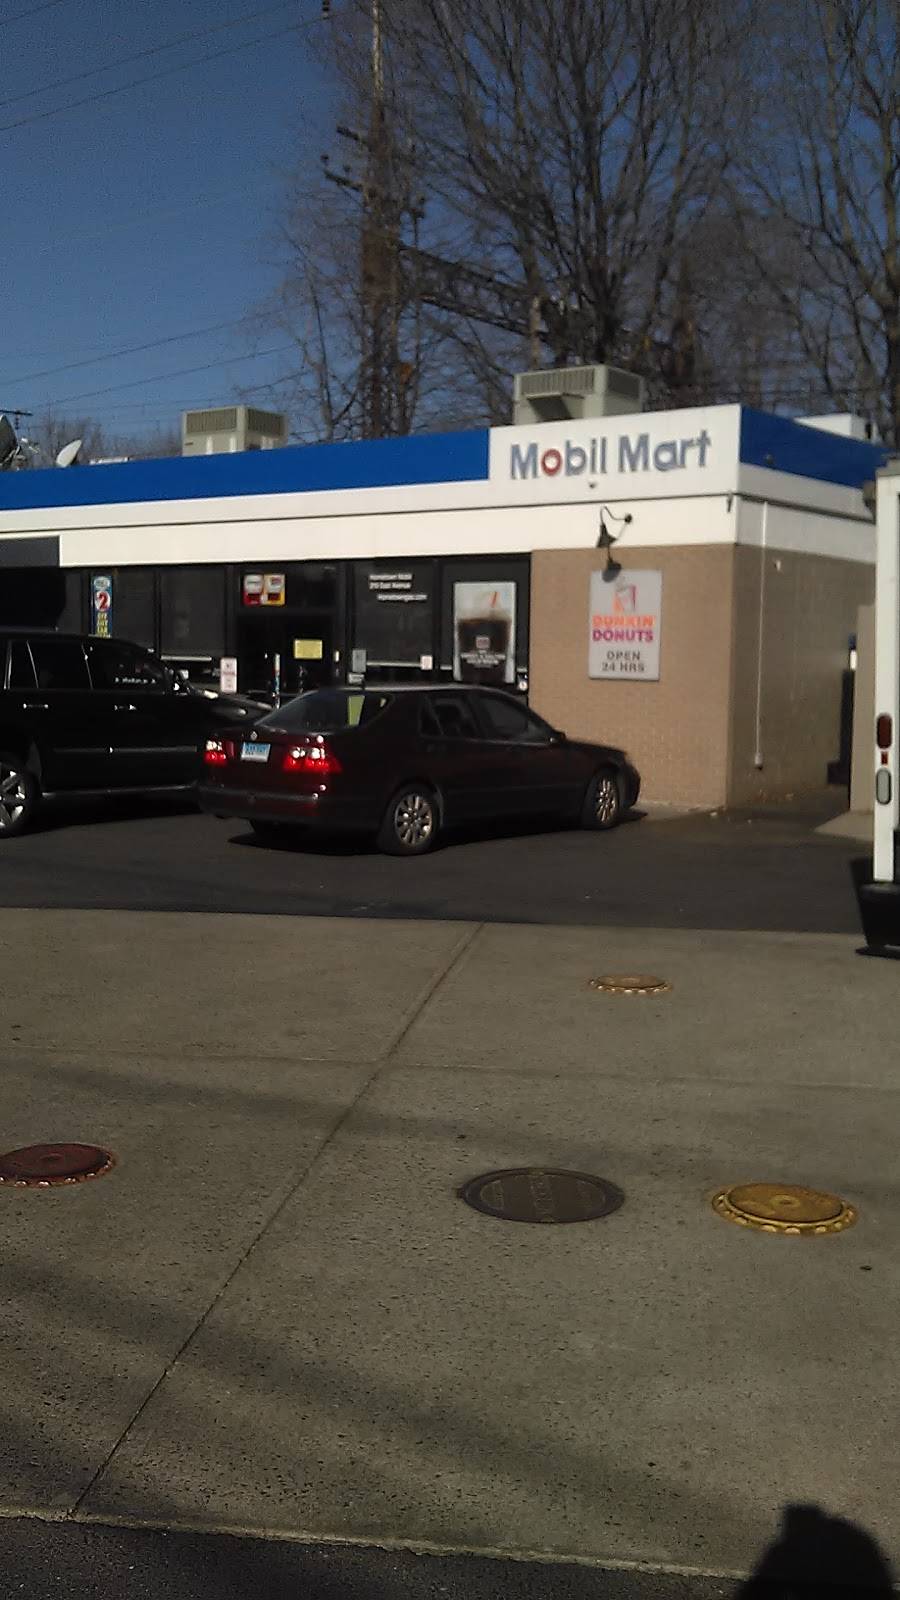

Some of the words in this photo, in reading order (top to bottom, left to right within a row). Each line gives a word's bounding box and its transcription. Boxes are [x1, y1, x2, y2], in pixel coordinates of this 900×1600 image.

[510, 437, 607, 480] Mobil
[618, 429, 711, 473] Mart
[98, 591, 109, 610] 2
[592, 629, 654, 642] DONUTS
[607, 650, 641, 661] OPEN
[602, 661, 616, 672] 24
[620, 661, 645, 672] HRS
